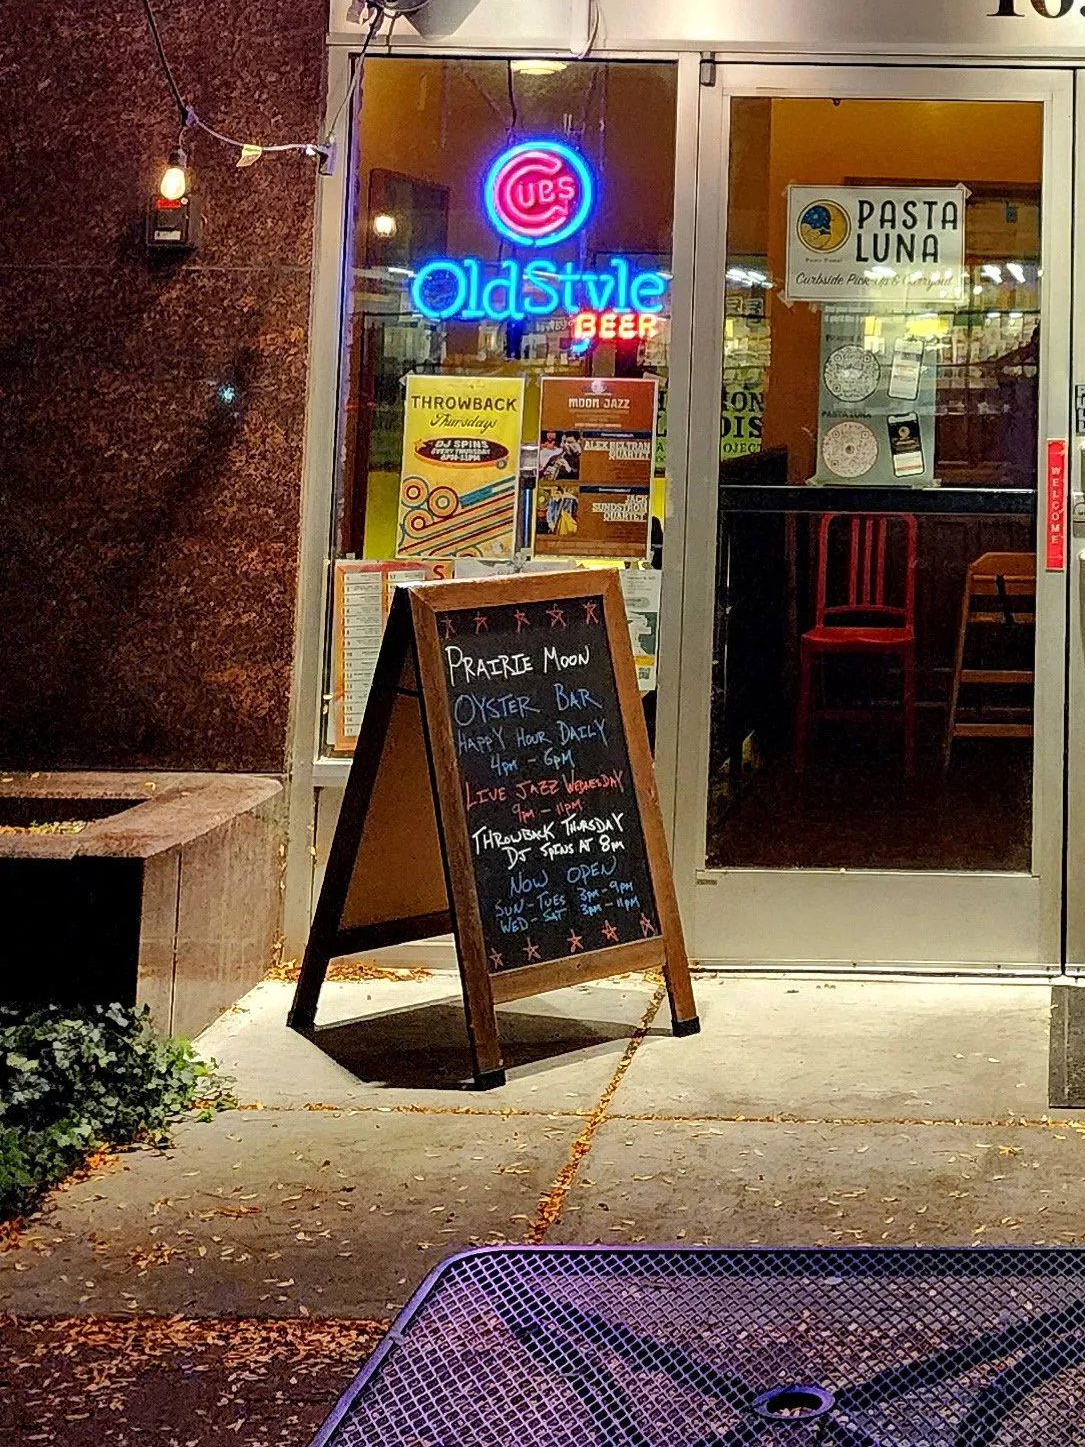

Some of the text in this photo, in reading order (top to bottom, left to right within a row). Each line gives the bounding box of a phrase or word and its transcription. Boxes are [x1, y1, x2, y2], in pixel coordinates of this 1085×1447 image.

[857, 199, 959, 231] PASTA
[855, 232, 939, 264] LUNA
[795, 272, 846, 286] Curbside
[574, 313, 659, 340] BEER
[411, 395, 518, 412] THROWBACK
[568, 397, 631, 410] MOON JAZZ
[430, 413, 498, 435] Thursdays
[434, 439, 490, 449] DJ SPINS
[583, 440, 651, 452] ALEX BELTRAN
[608, 450, 651, 461] QUARTET
[625, 494, 648, 504] JACK
[1051, 466, 1061, 544] WELCOME
[445, 644, 591, 687] PRAIRIE MOON
[454, 682, 603, 726] OYSTER BAR
[458, 718, 609, 756] HAPPY HOUR DAILY
[465, 769, 625, 811] LIVE JAZZ WEDNESDAY
[471, 812, 624, 855] THROWBACK THURSDAY
[501, 846, 532, 871] DJ
[539, 842, 575, 861] SPINS
[579, 838, 594, 853] AT
[510, 855, 618, 898] NOW OPEN
[494, 898, 524, 918] SUN
[536, 889, 567, 911] TUES
[499, 916, 529, 934] WED
[541, 907, 568, 923] SAT
